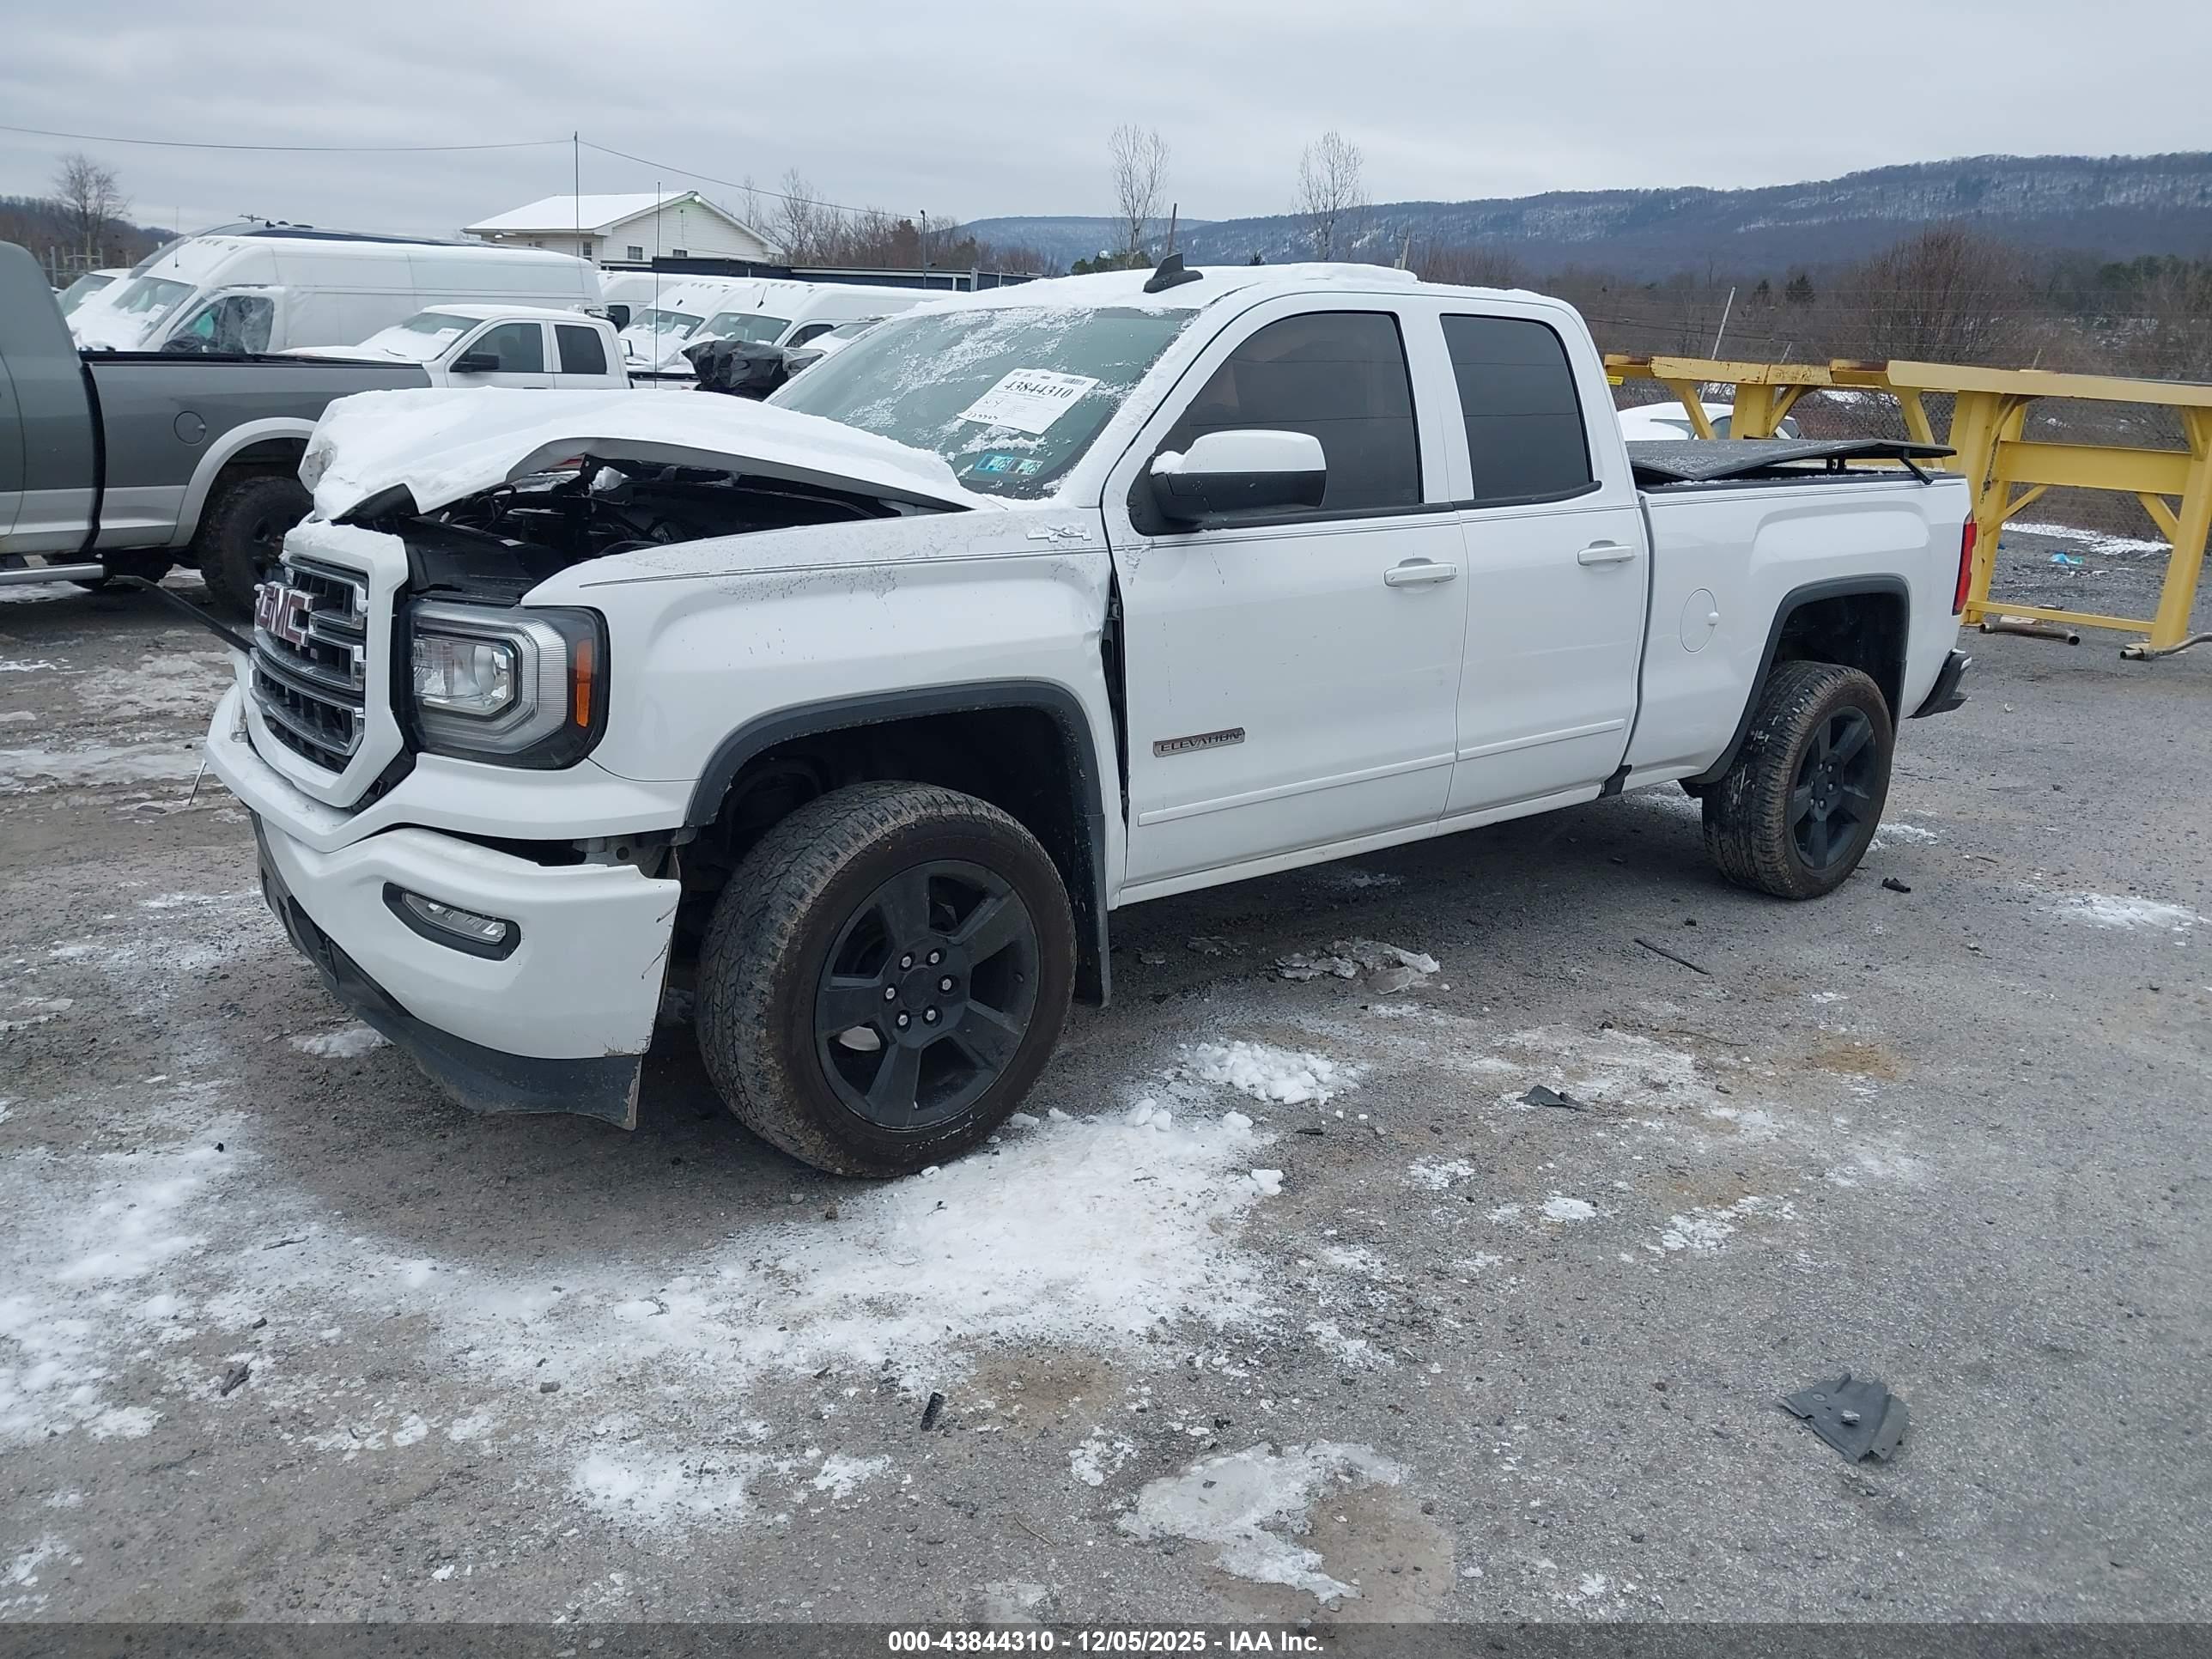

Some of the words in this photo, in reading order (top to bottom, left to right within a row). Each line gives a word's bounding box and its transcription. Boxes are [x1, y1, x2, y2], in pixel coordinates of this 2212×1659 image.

[1004, 380, 1074, 399] 43844310
[256, 582, 313, 647] GMC
[1160, 732, 1243, 752] ELEVATION
